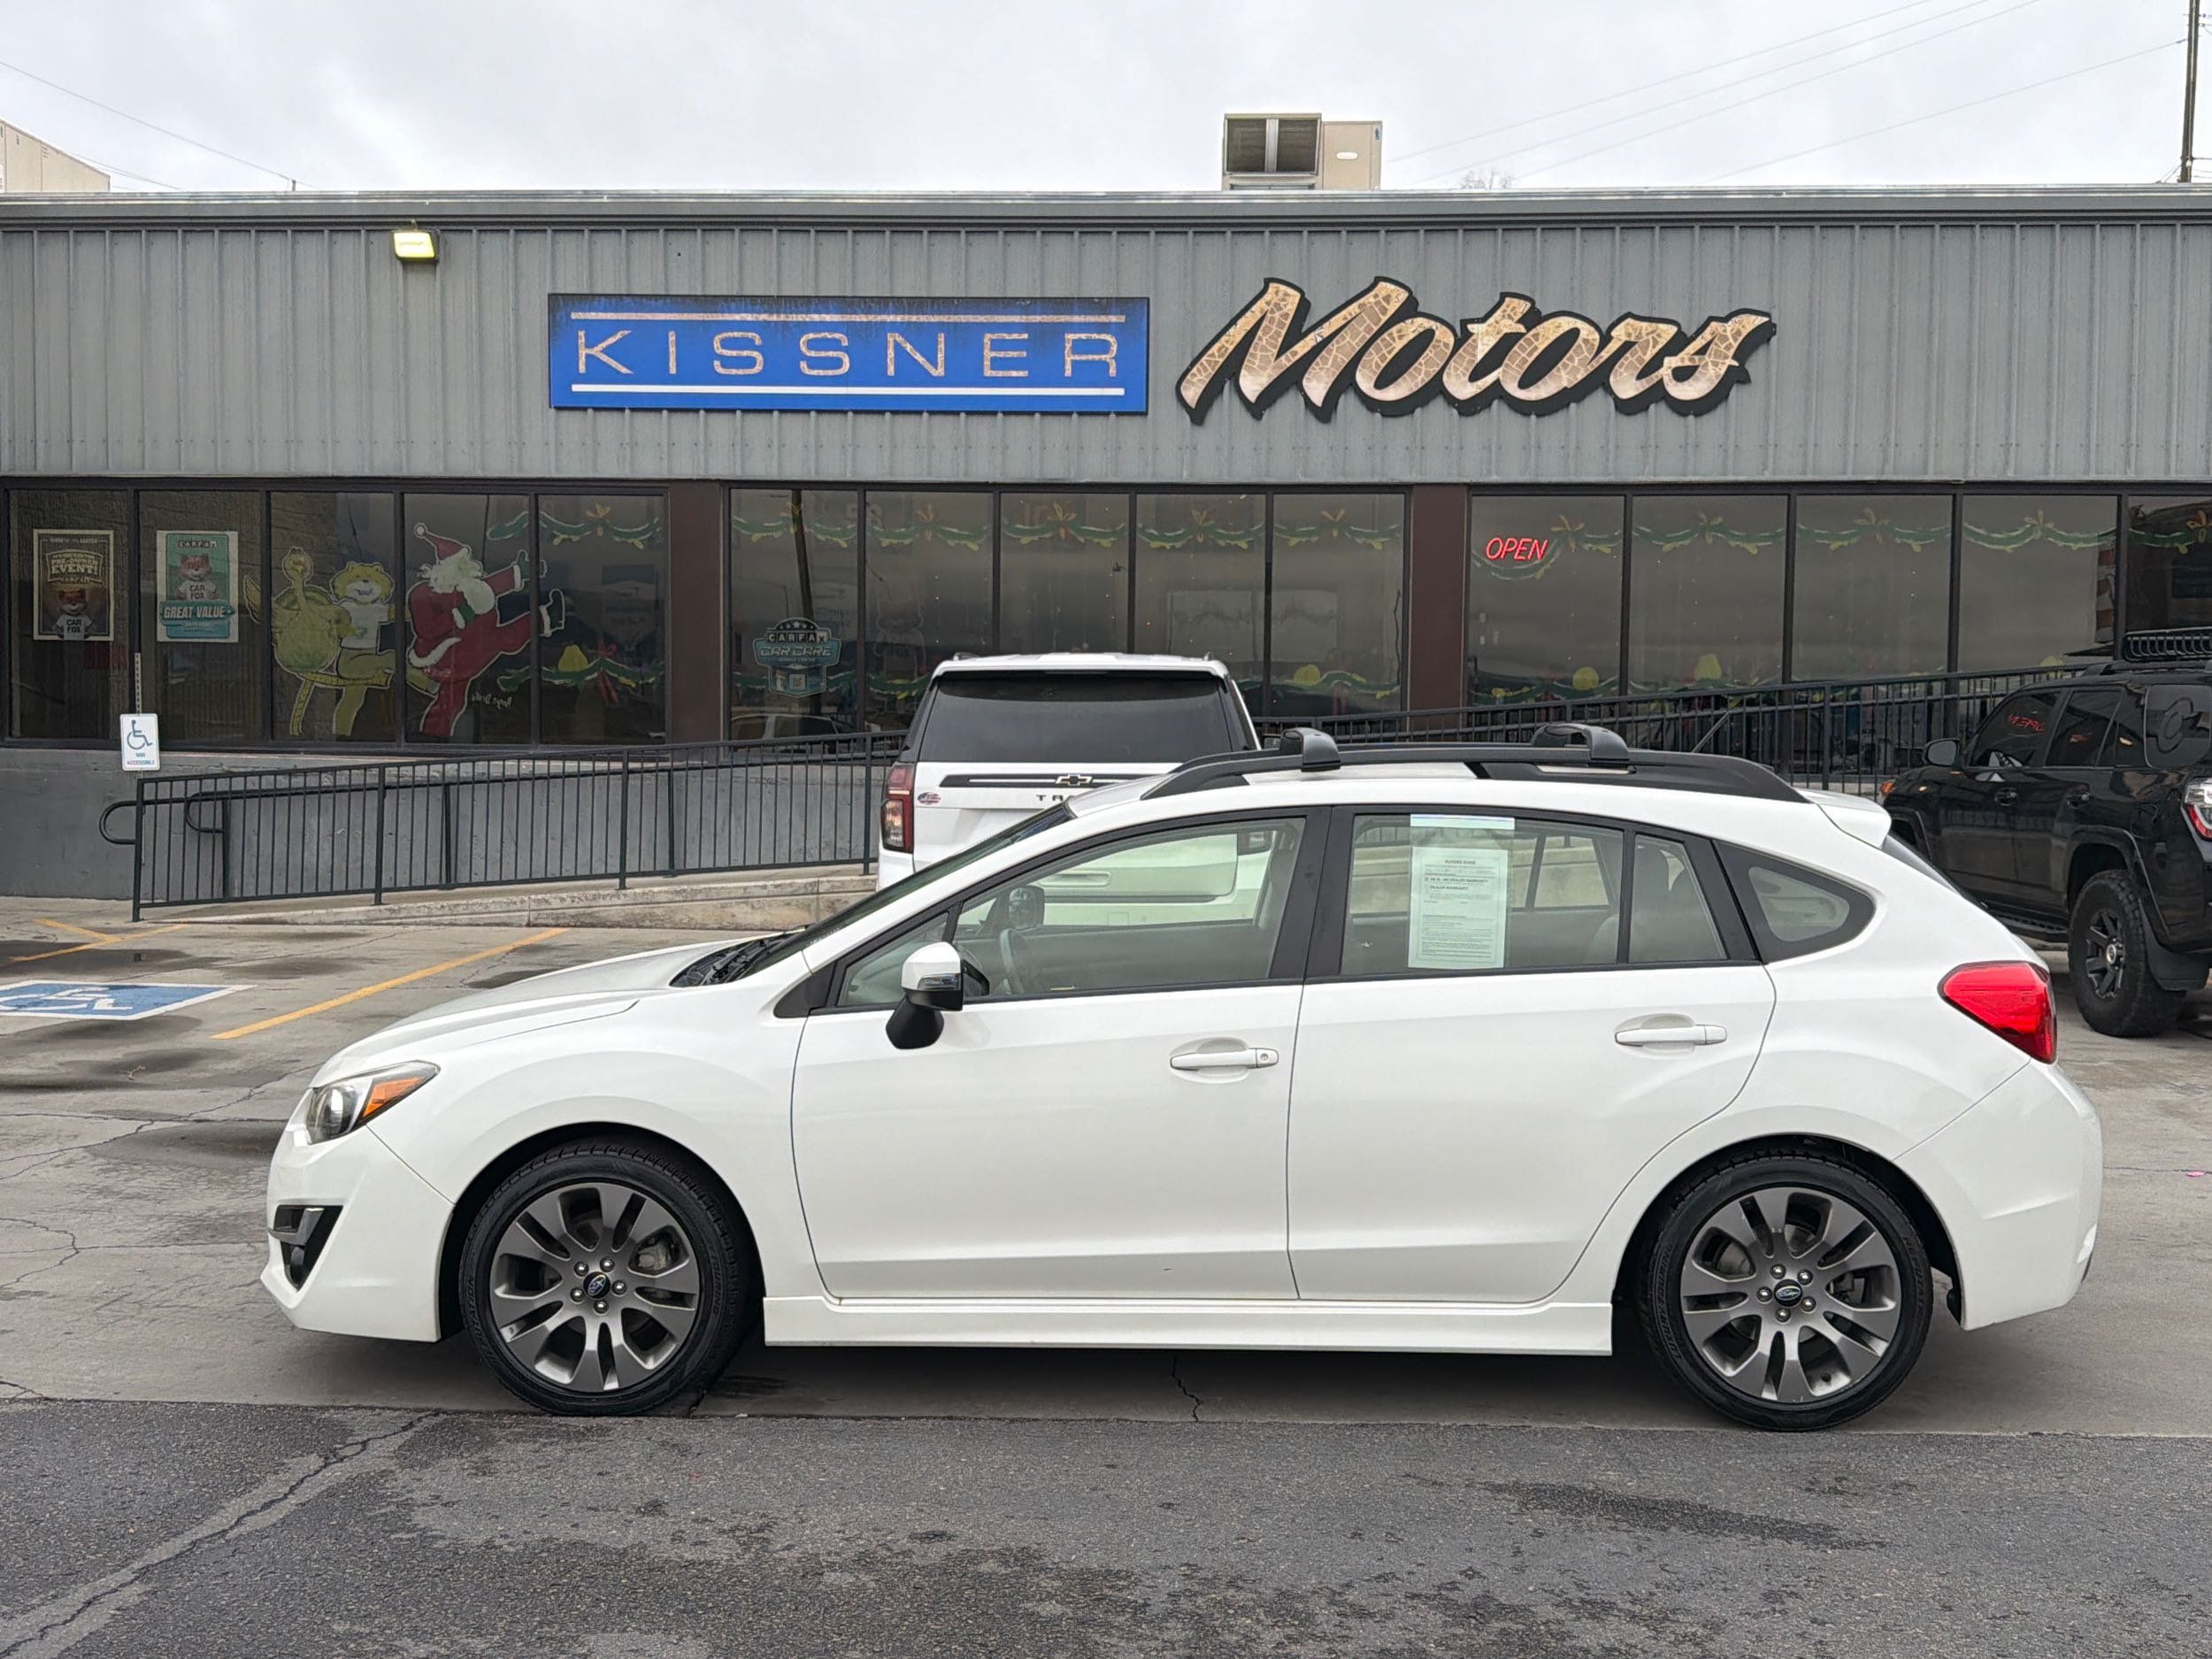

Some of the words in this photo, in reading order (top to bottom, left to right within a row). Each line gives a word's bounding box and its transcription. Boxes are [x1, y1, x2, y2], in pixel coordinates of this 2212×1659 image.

[578, 330, 1118, 376] KISSNER
[1177, 277, 1773, 421] Motors
[1486, 537, 1549, 560] OPEN
[51, 564, 98, 575] EVENT!
[164, 606, 195, 618] GREAT
[196, 606, 226, 618] VALUE
[768, 632, 827, 643] CARFAX
[760, 646, 790, 657] CAR
[792, 646, 832, 657] CARE
